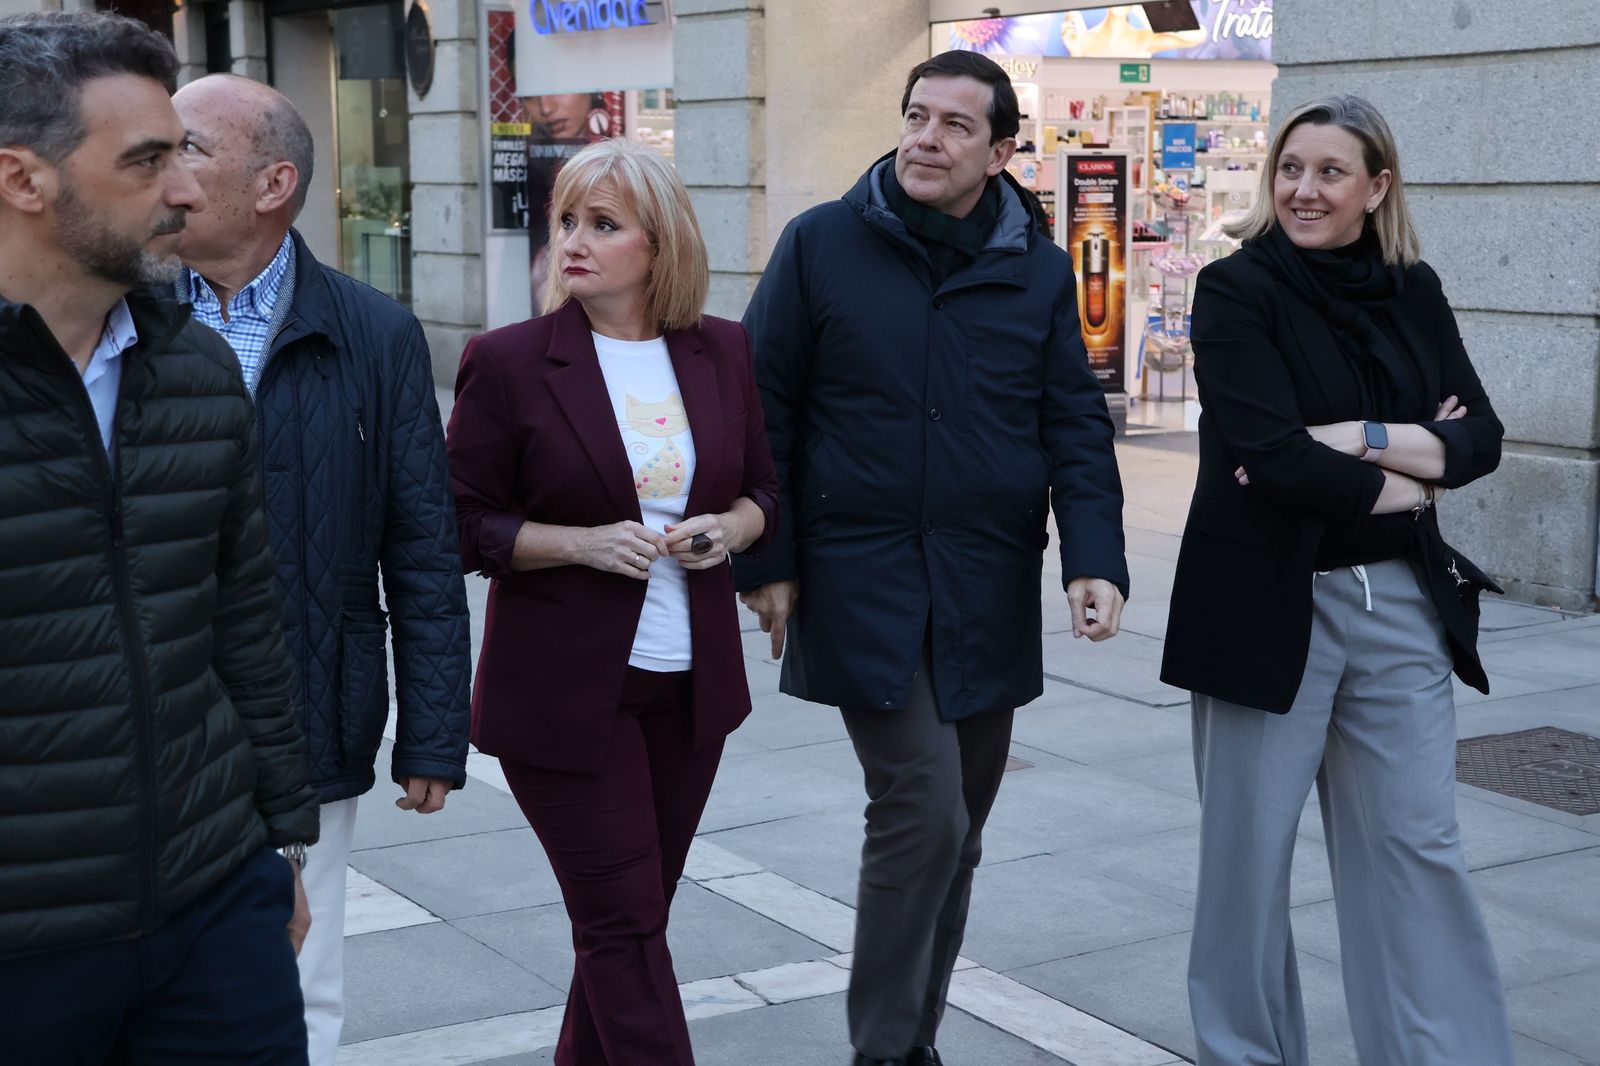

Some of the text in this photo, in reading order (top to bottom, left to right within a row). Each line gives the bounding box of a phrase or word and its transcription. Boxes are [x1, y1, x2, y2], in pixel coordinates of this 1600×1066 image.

[1000, 57, 1038, 77] sley
[1079, 163, 1113, 171] CLARINS
[1074, 177, 1119, 186] Double Serum
